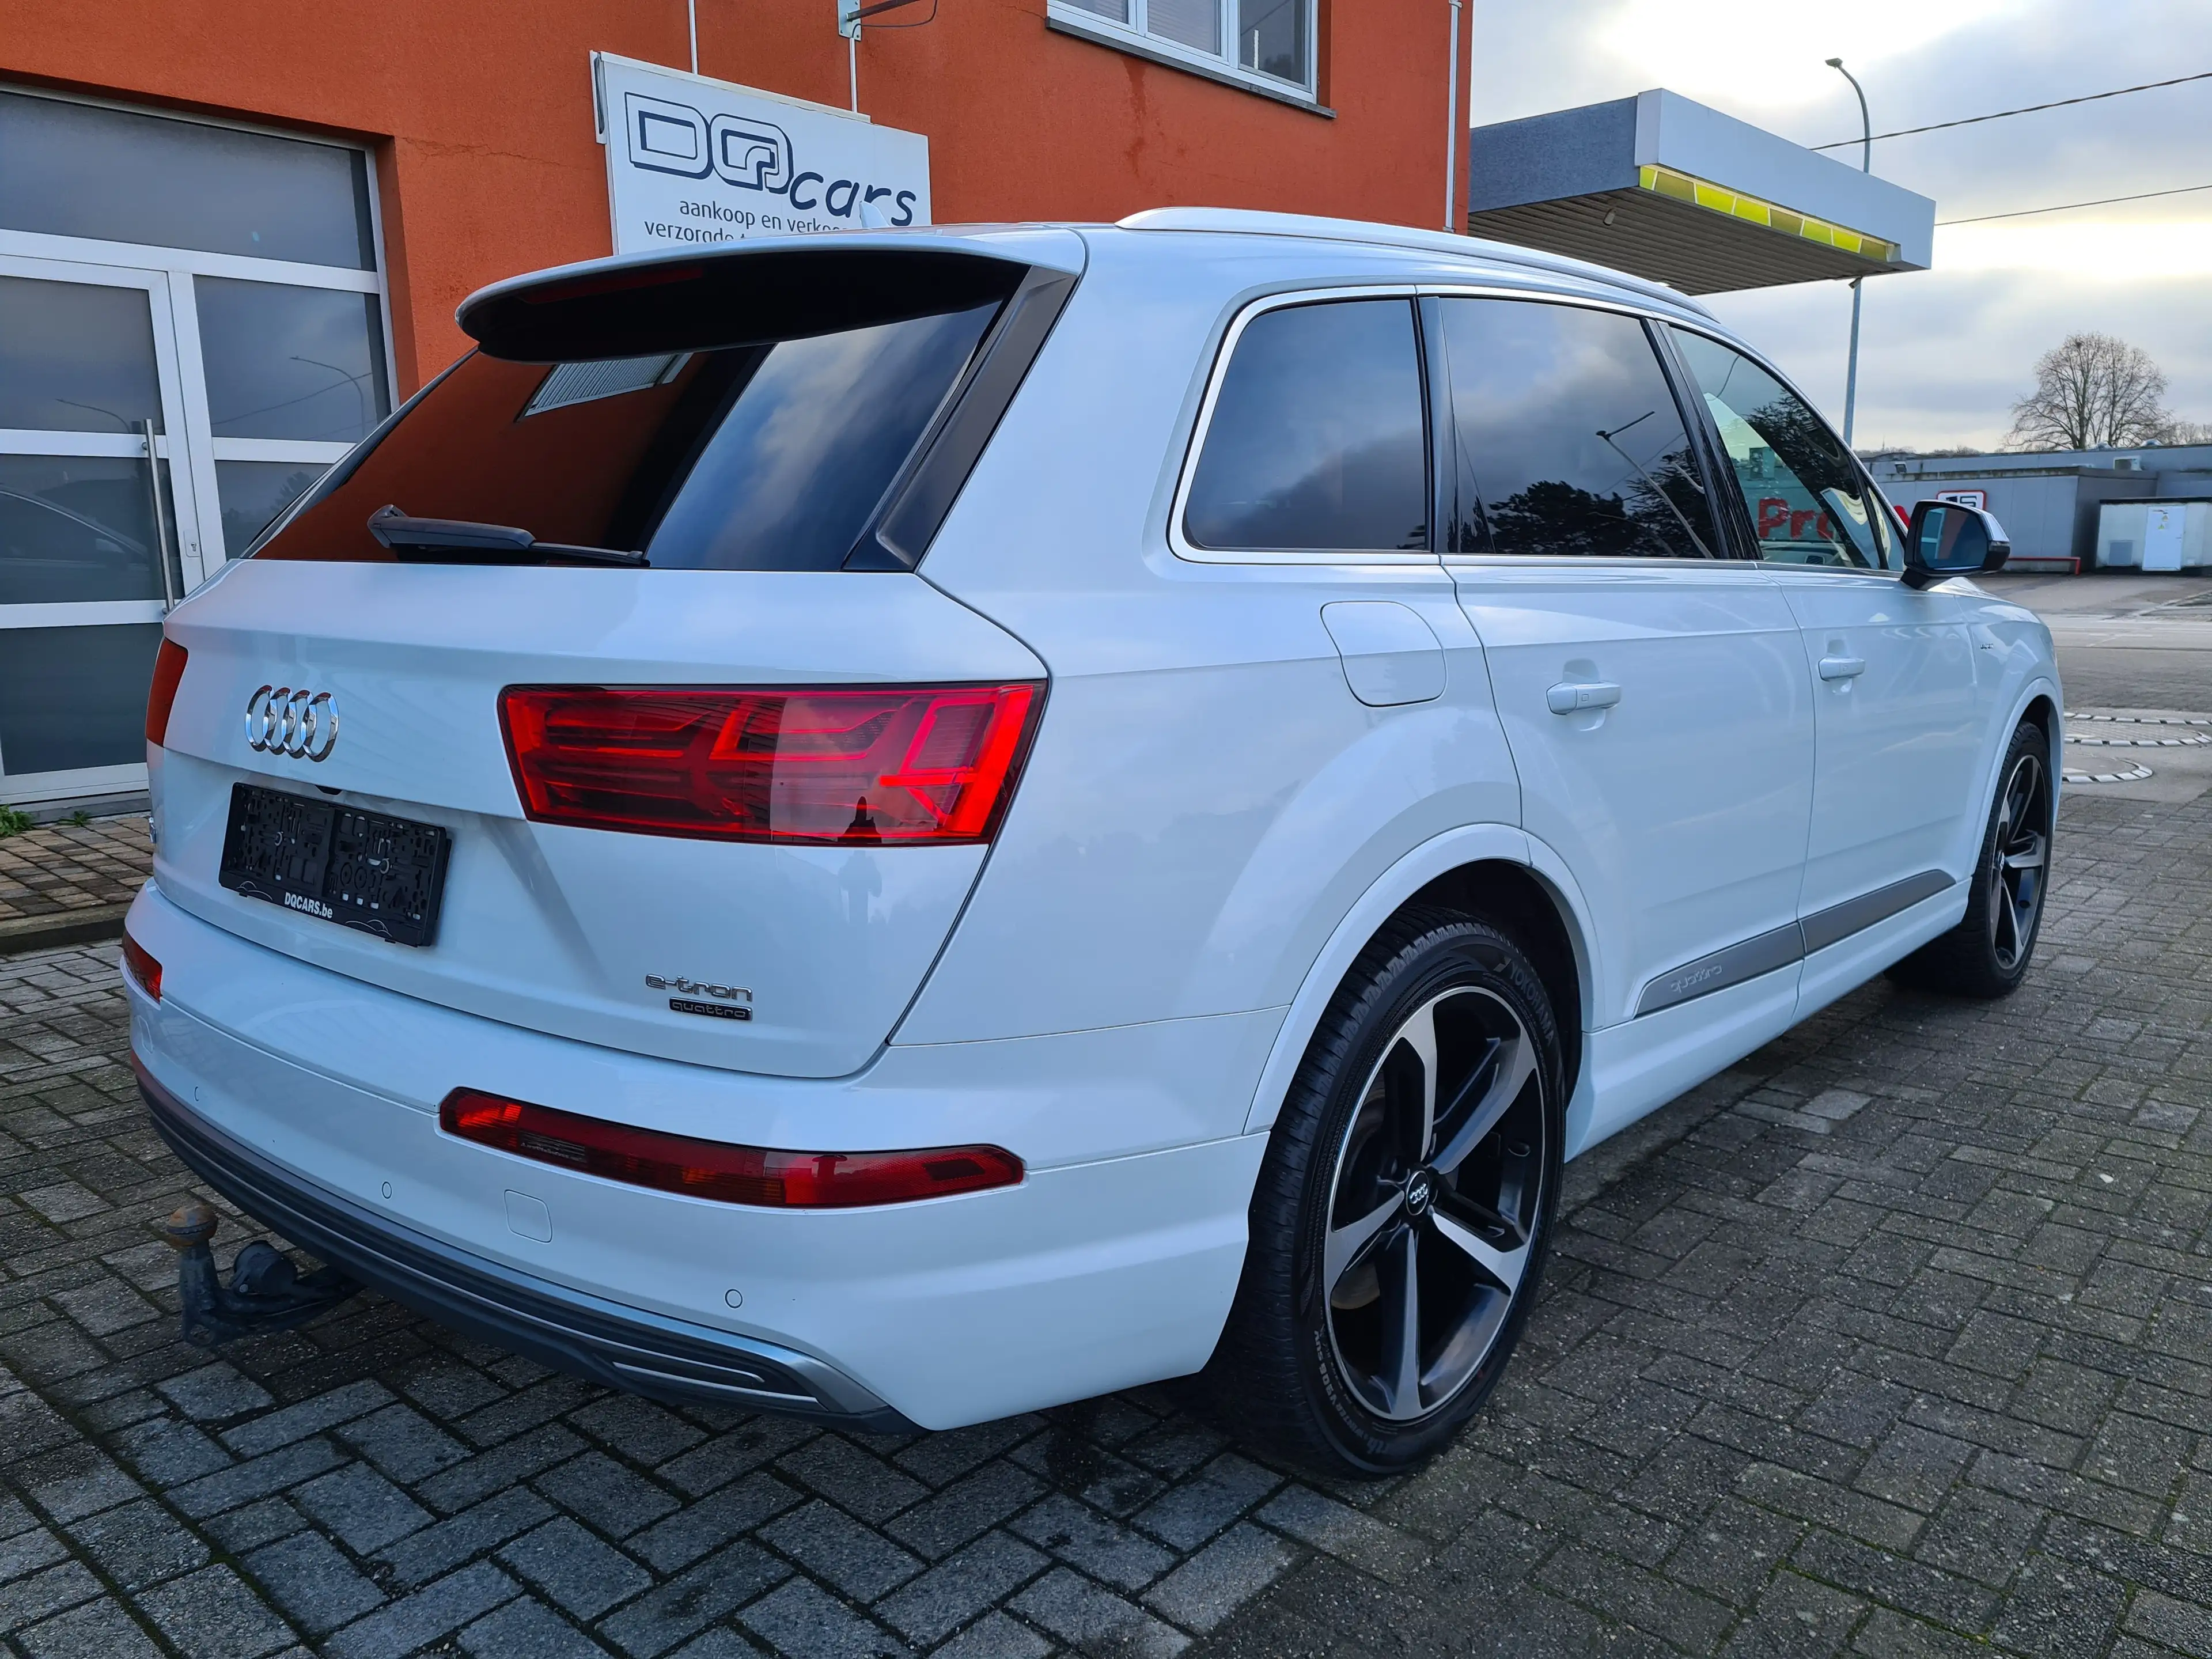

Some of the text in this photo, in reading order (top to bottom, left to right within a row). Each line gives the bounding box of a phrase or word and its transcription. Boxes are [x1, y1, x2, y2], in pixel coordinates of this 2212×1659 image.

[680, 200, 755, 229] aankoop
[762, 215, 781, 230] en
[285, 892, 333, 919] DQCARS.be
[645, 974, 753, 1002] e-tron
[1671, 965, 1722, 994] quattro
[672, 1002, 745, 1018] quattro
[1510, 961, 1554, 1047] YOKOHAMA
